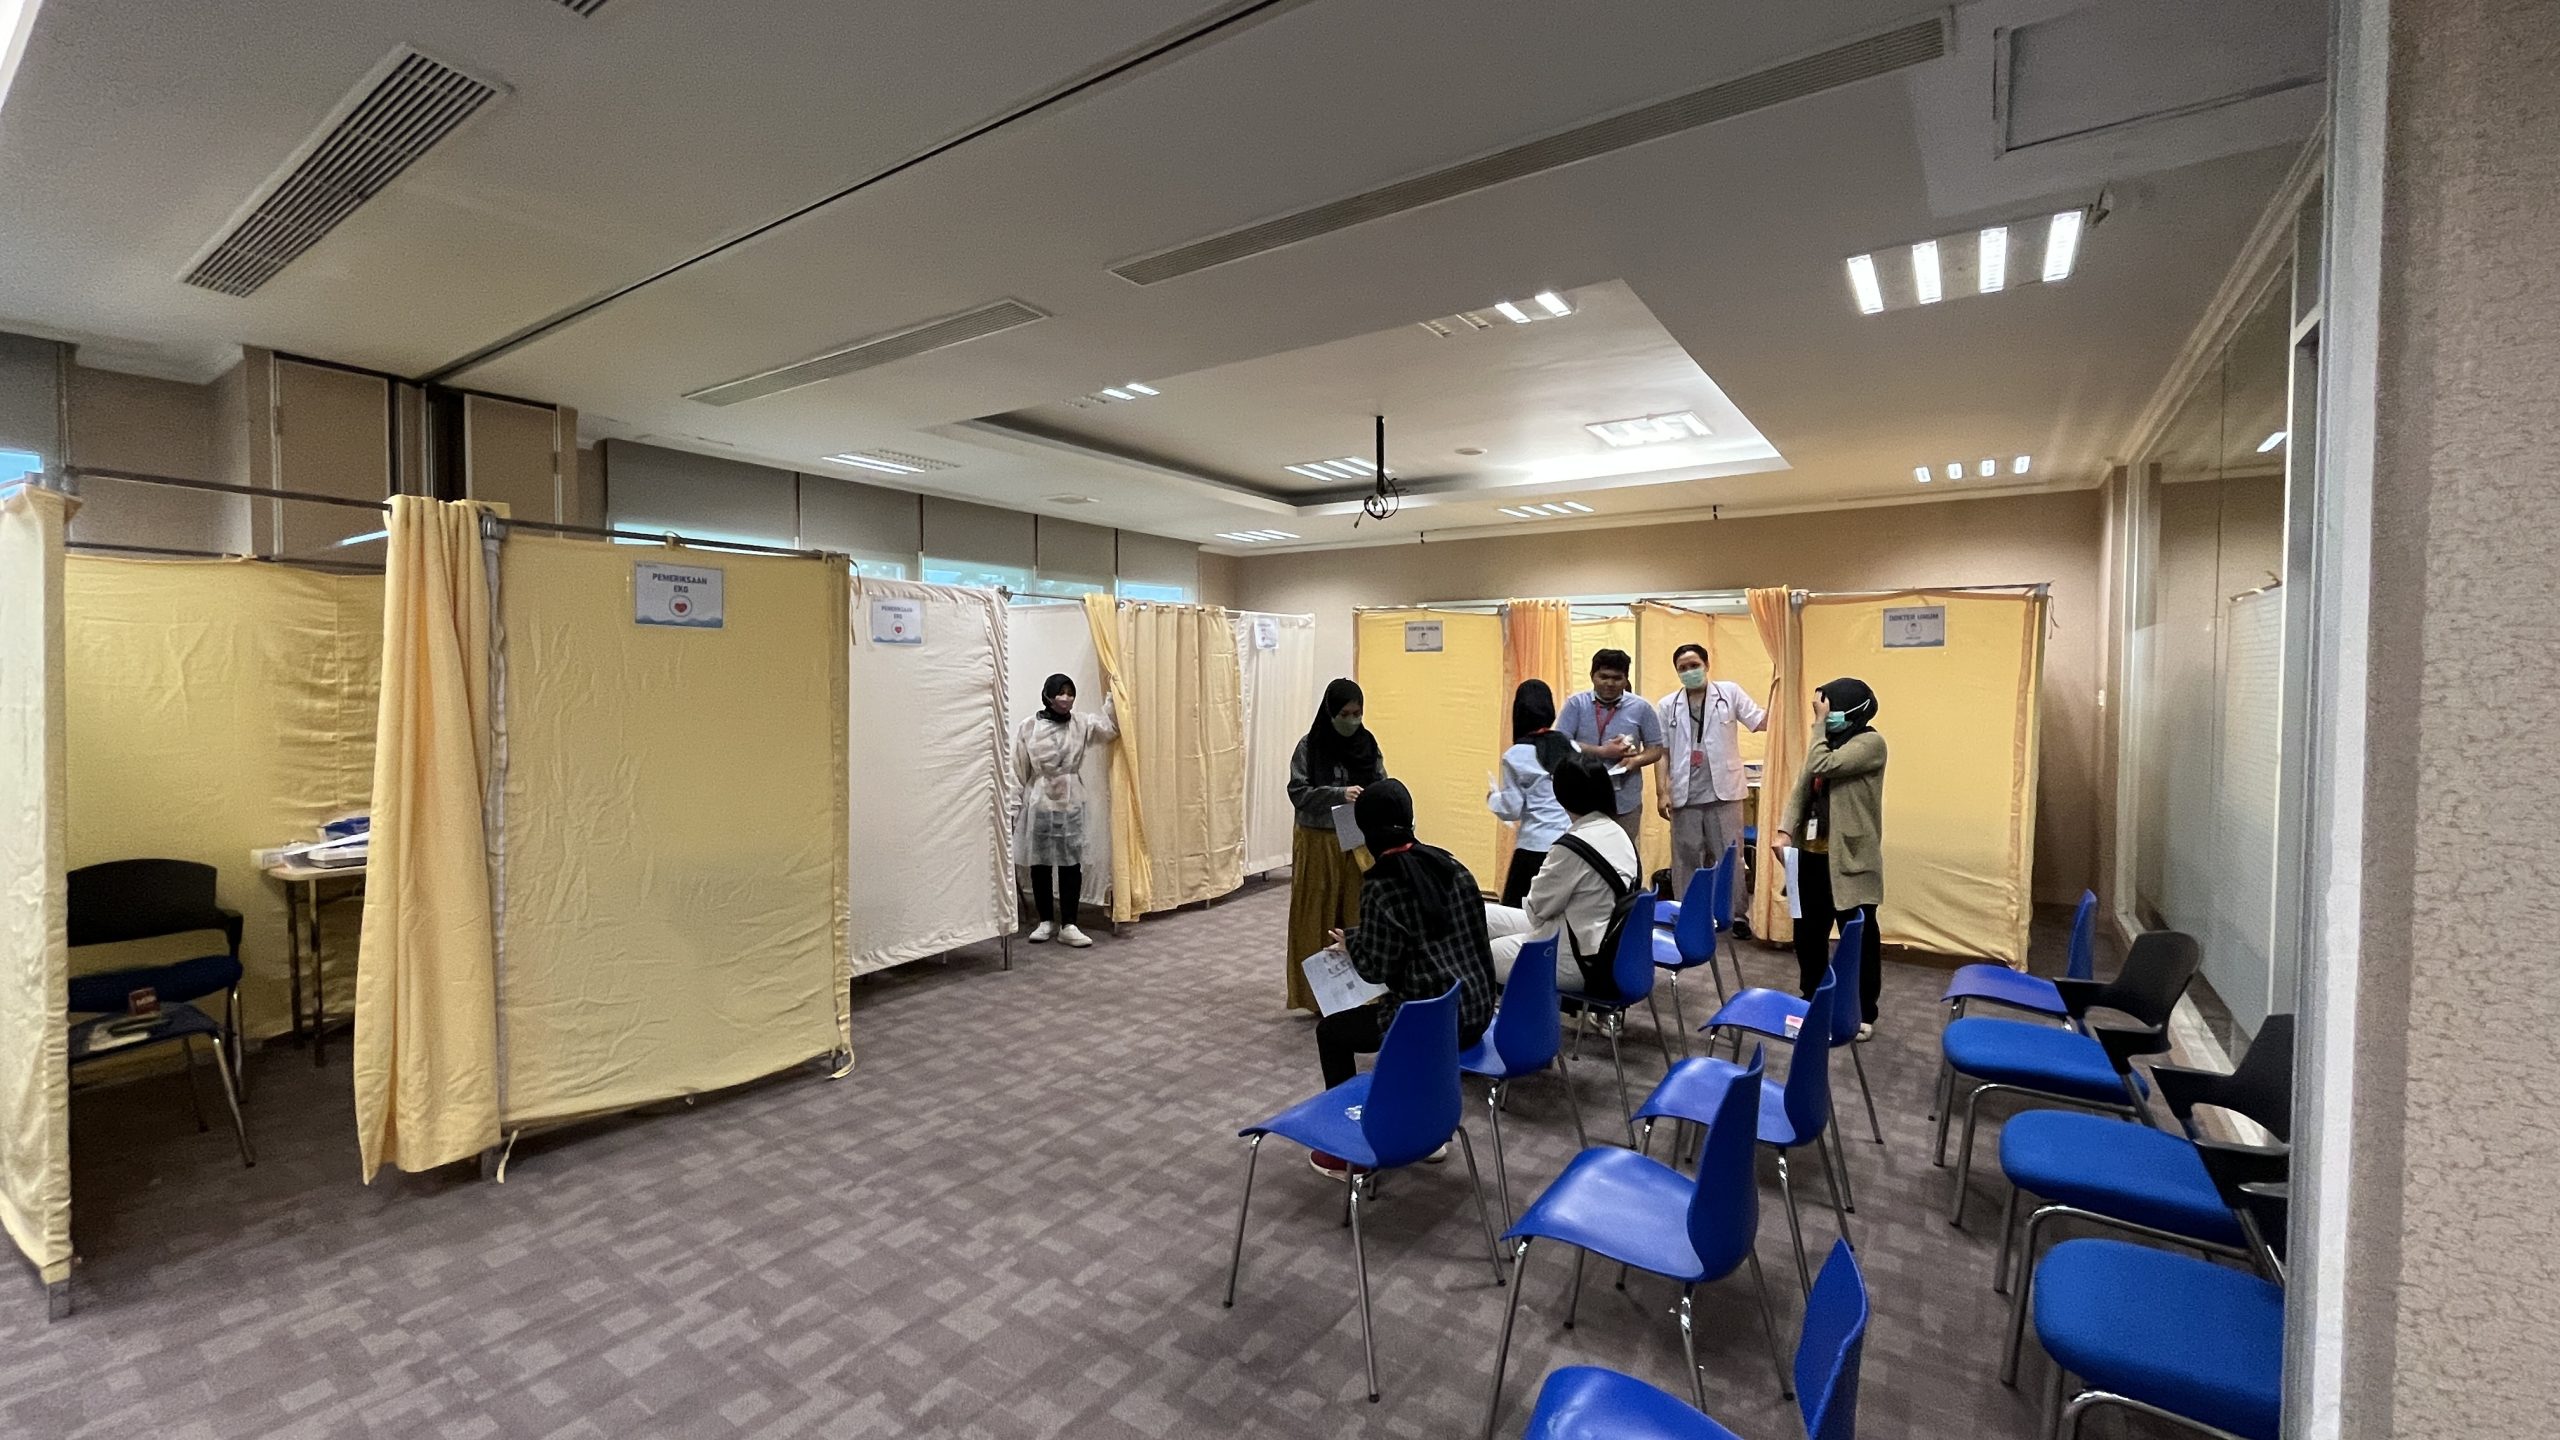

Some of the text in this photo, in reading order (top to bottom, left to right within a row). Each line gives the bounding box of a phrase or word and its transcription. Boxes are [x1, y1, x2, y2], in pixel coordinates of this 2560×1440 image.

[652, 573, 708, 585] PEMERIKSAAN
[673, 585, 690, 594] EKG
[1889, 612, 1939, 622] DOKTER UMUM
